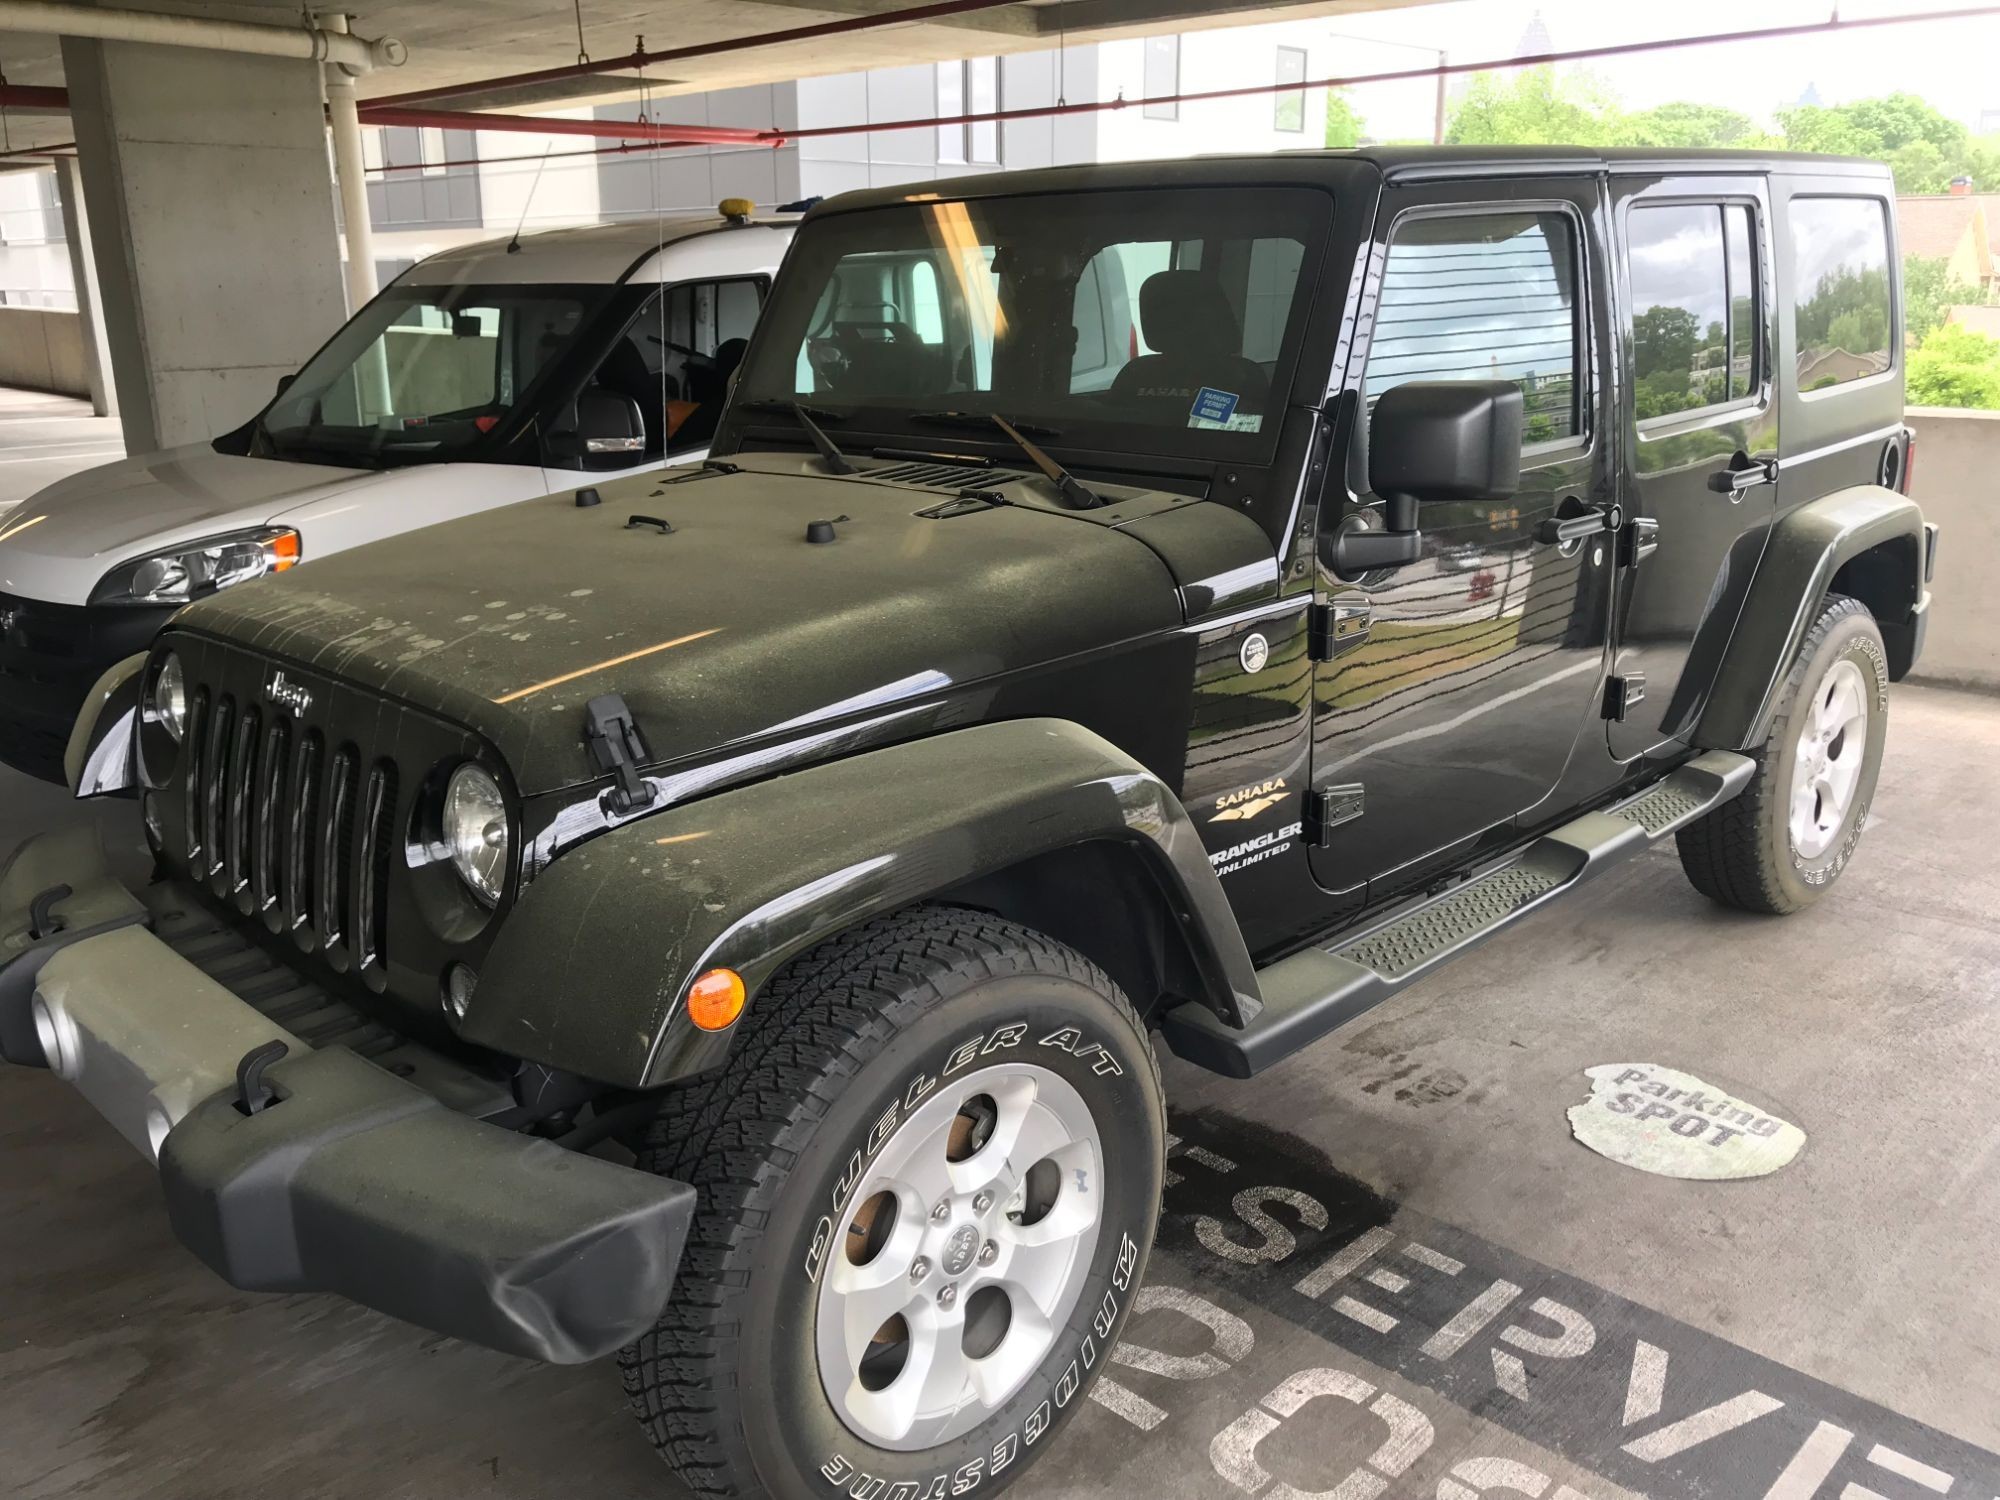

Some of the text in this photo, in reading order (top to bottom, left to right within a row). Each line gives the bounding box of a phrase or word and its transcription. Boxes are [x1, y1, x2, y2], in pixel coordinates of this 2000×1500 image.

[1136, 387, 1199, 397] SAHAR
[1202, 399, 1228, 410] PERMIT
[1203, 392, 1232, 405] PARKING
[266, 671, 313, 718] Jeep
[1215, 777, 1286, 810] SAHARA
[1605, 1092, 1747, 1148] SPOT
[1612, 1067, 1783, 1138] Parking
[806, 1022, 1124, 1284] DUELER A/T
[820, 1231, 1139, 1500] BRIDGESTONE
